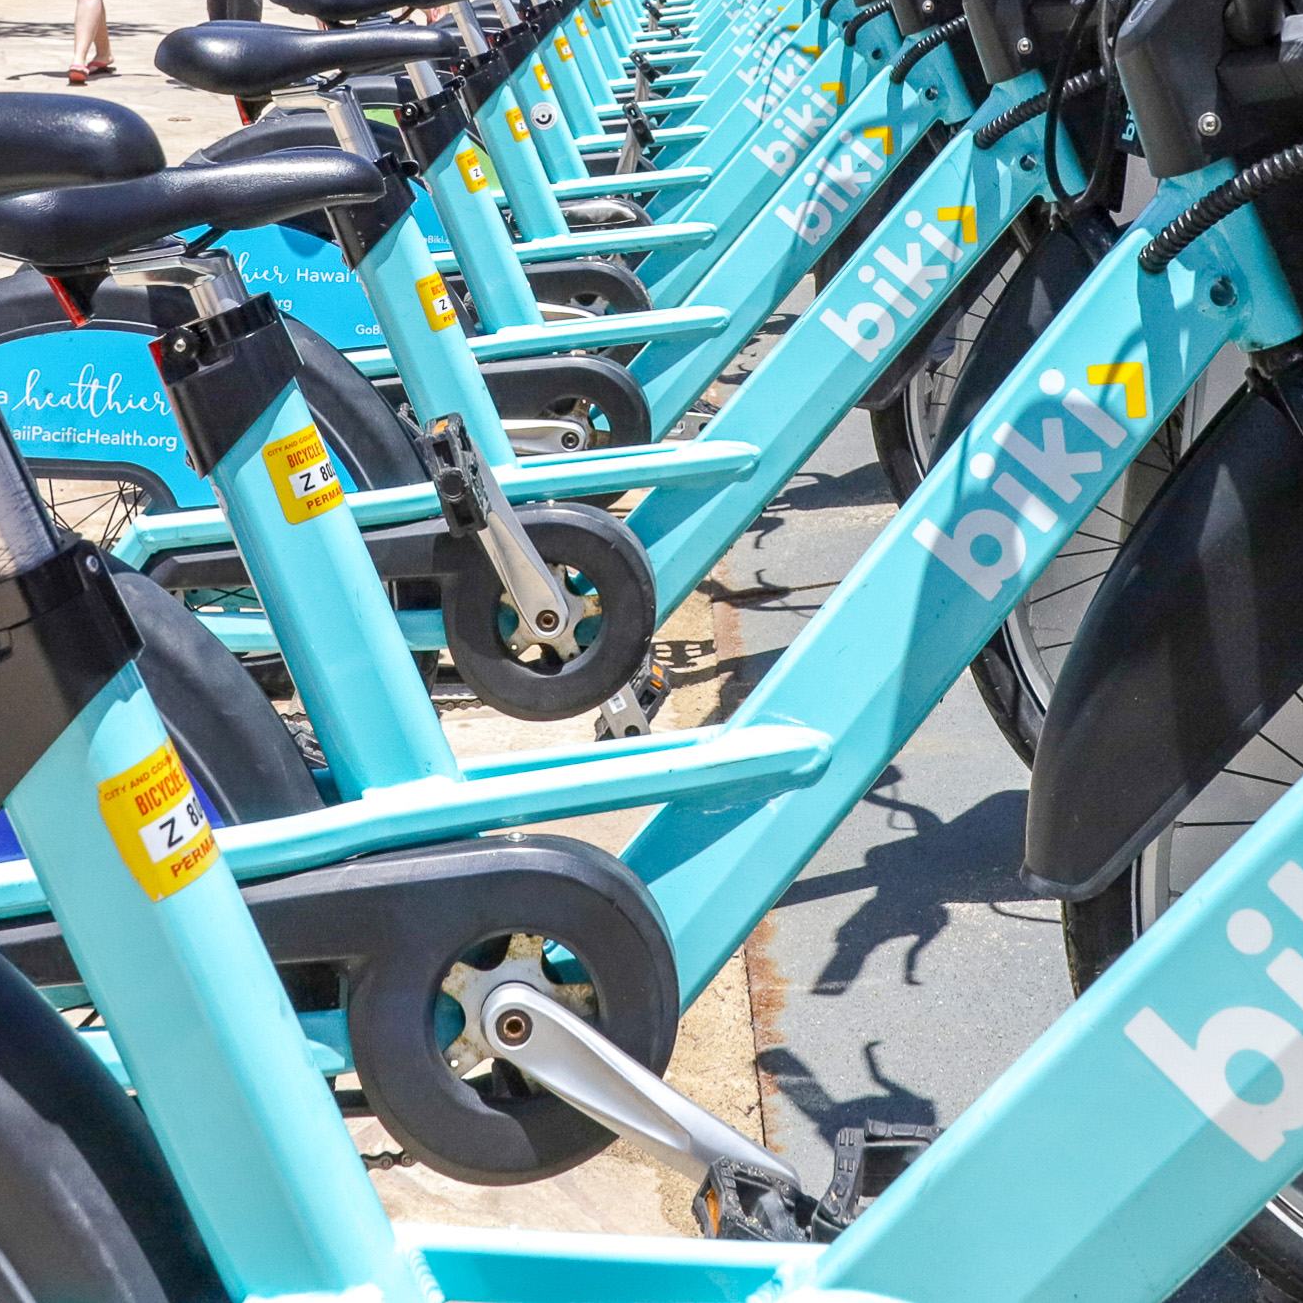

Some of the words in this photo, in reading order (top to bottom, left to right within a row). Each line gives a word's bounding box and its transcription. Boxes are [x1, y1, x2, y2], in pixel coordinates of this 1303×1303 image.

[750, 85, 838, 177] biki
[774, 130, 884, 245] biki
[819, 210, 964, 363] biki
[438, 298, 448, 311] Z
[12, 426, 178, 452] aiiPacificHealth.org
[267, 447, 283, 457] CITY
[284, 440, 298, 450] AND
[287, 442, 321, 468] BICYCLE
[299, 472, 316, 492] Z
[306, 485, 343, 510] PERMA
[912, 368, 1128, 601] biki
[104, 785, 127, 801] CITY
[130, 770, 150, 789] AND
[135, 768, 184, 816] BICYCLE
[159, 816, 184, 849] Z
